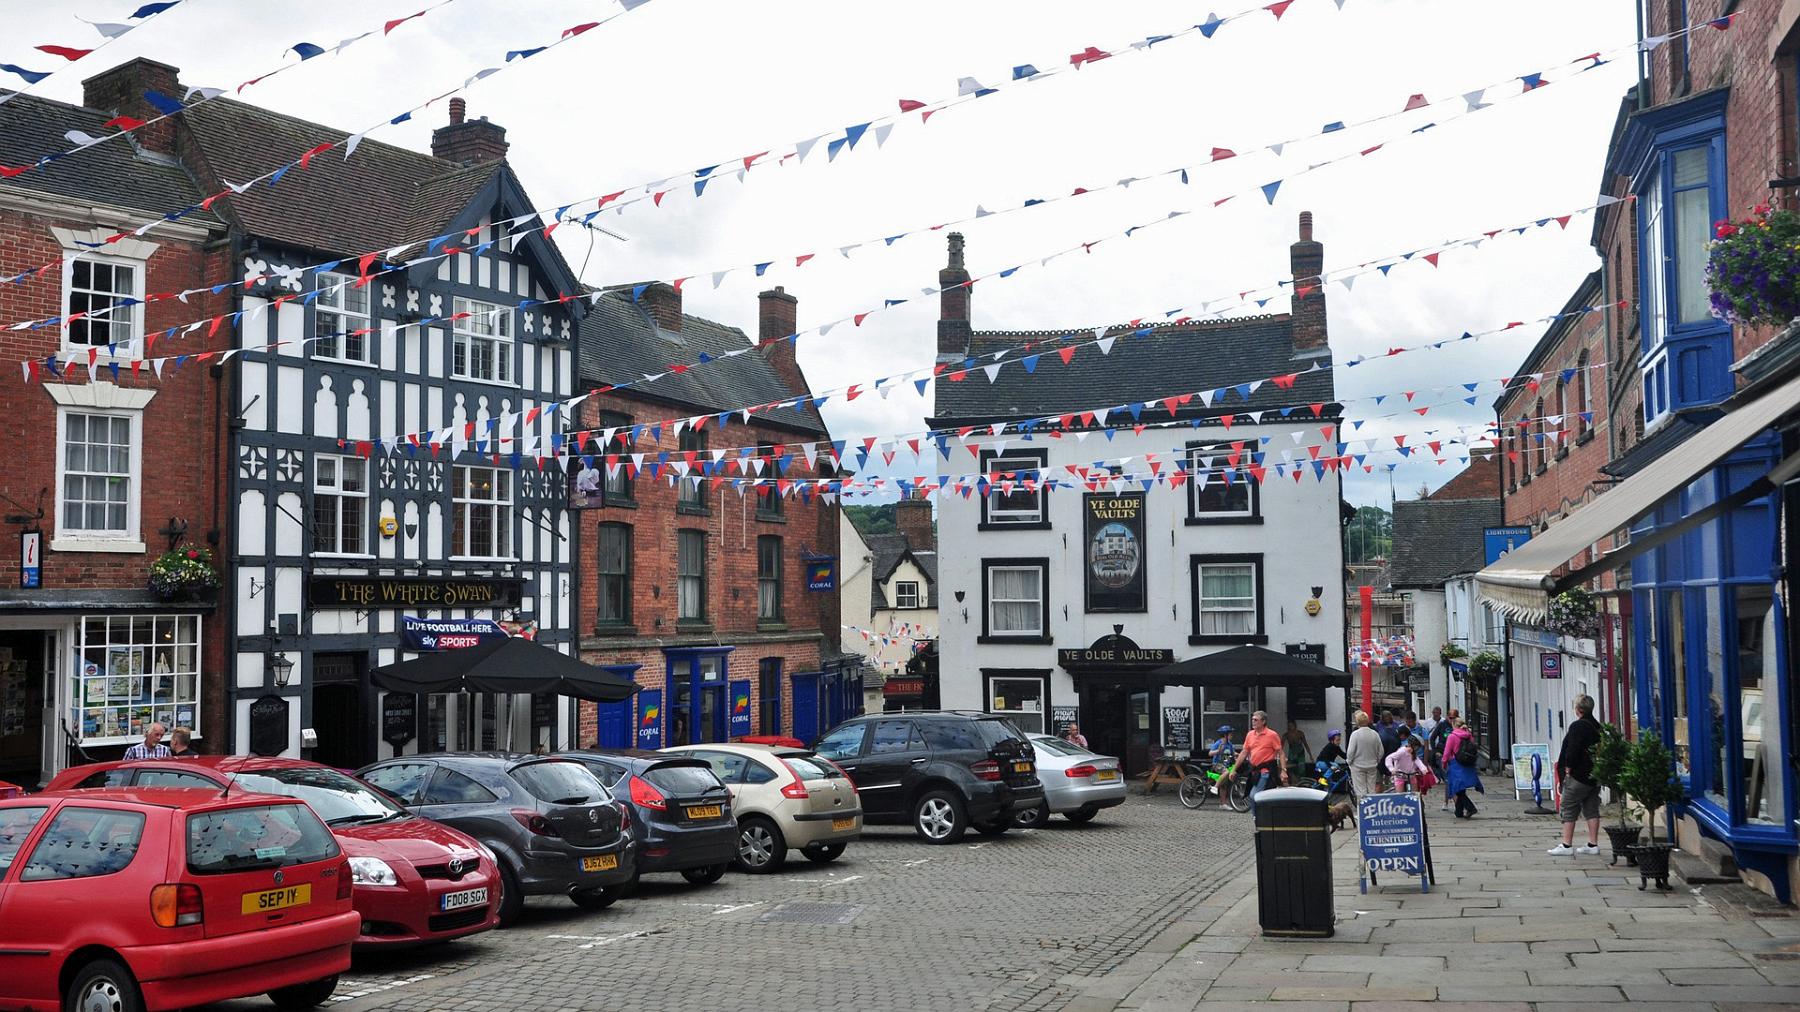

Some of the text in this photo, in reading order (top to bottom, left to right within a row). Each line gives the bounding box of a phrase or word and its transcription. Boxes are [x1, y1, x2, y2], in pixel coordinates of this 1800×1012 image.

[1090, 499, 1140, 509] YE OLDE
[1094, 509, 1136, 519] VAULTS
[335, 581, 492, 605] THE WHITE SWAN
[406, 621, 493, 634] LIVE FOOTBALL HERE
[422, 635, 478, 648] sky SPORTS
[1064, 649, 1163, 660] YE OLDE VAULTS
[732, 714, 749, 723] CORAL
[639, 727, 659, 737] CORAL
[1364, 799, 1415, 819] Elliots
[1368, 835, 1414, 844] FURNITURE
[1367, 857, 1418, 872] OPEN
[258, 891, 284, 908] SEP
[446, 889, 487, 908] FD08 SGX
